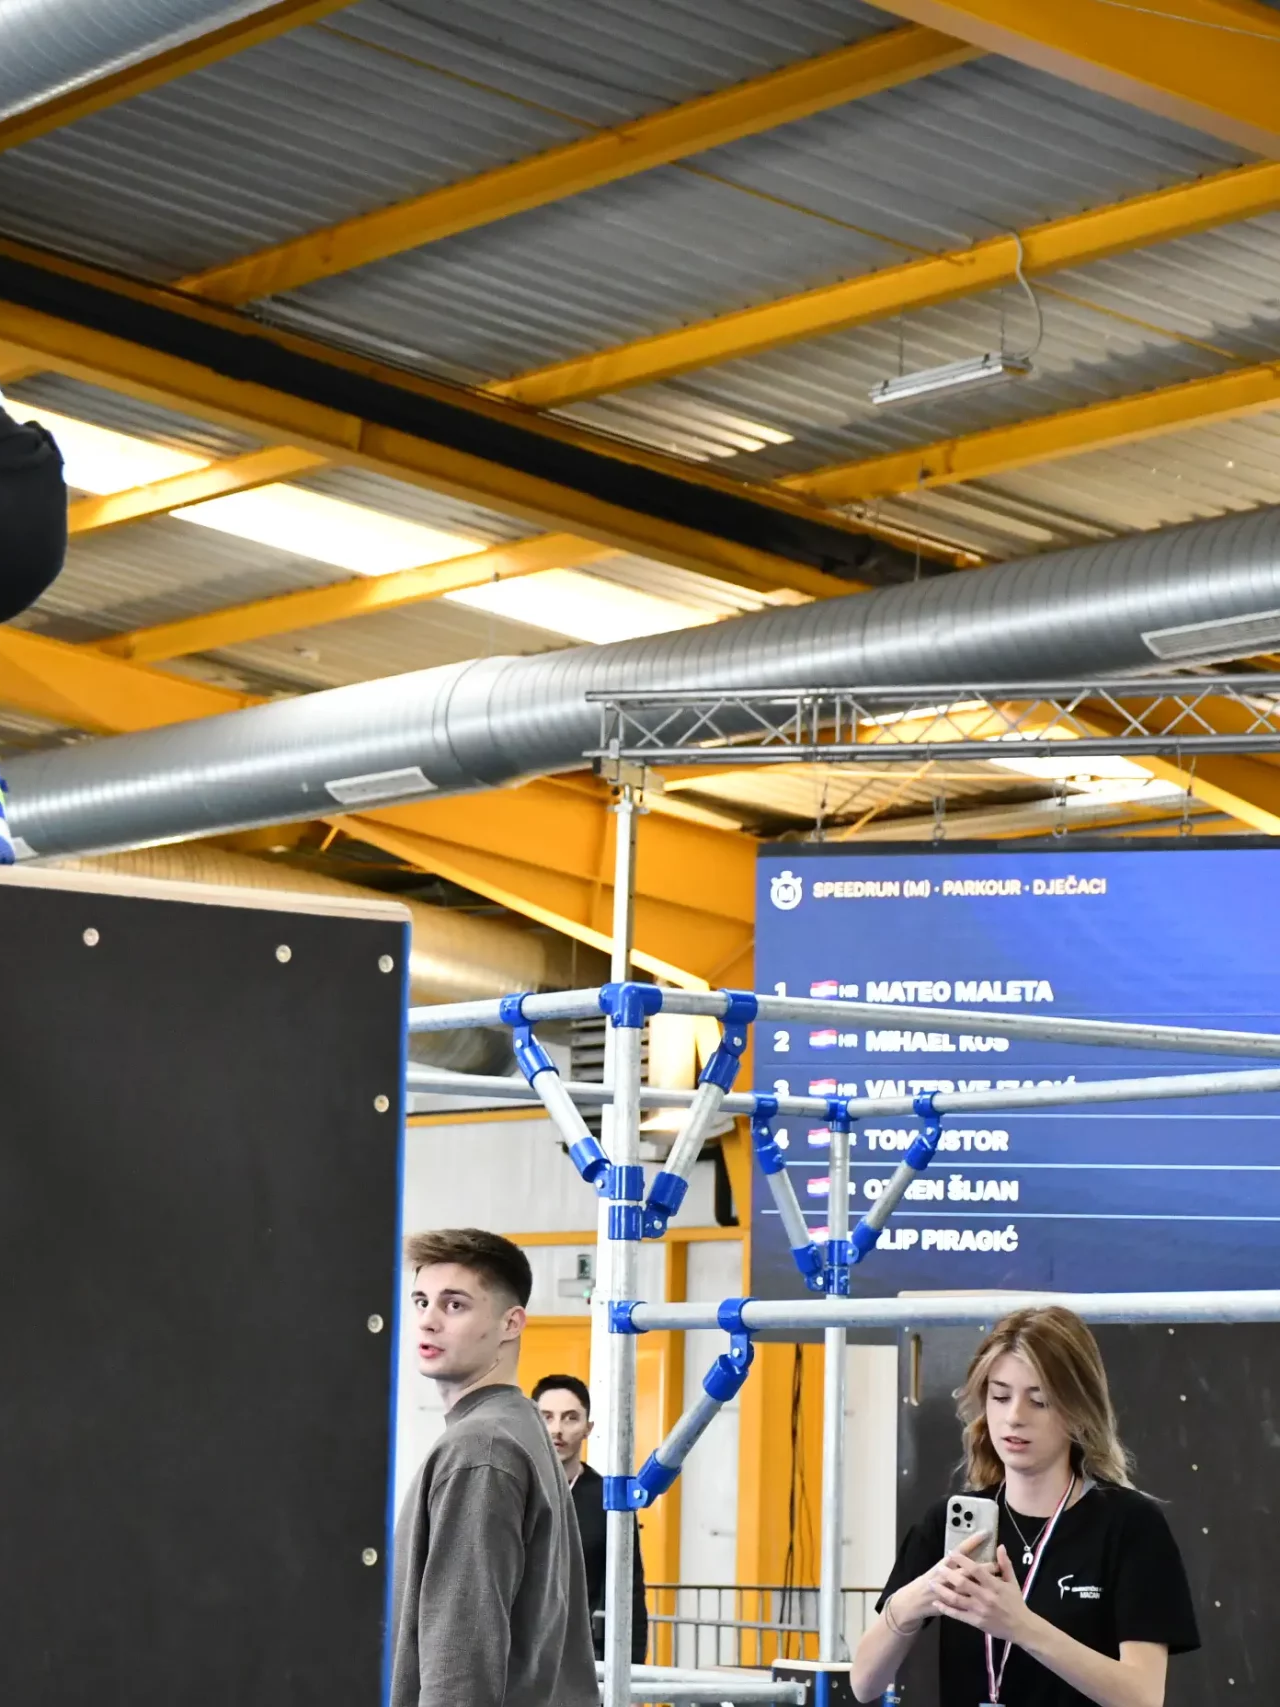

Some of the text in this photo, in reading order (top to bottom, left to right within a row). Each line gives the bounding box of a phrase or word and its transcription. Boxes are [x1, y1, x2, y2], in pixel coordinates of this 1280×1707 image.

[813, 875, 1106, 898] SPEEDRUN (M) PARKOUR DJEČACI
[774, 980, 1054, 1002] 1 HR MATEO MALETA
[773, 1031, 790, 1052] 2
[838, 1034, 858, 1048] HR
[866, 1030, 956, 1052] MIHAEL
[773, 1079, 789, 1098] 3
[837, 1083, 858, 1097] HR
[773, 1128, 790, 1150] 4
[948, 1174, 1019, 1202] ŠIJAN
[922, 1225, 1019, 1251] PIRAGIĆ
